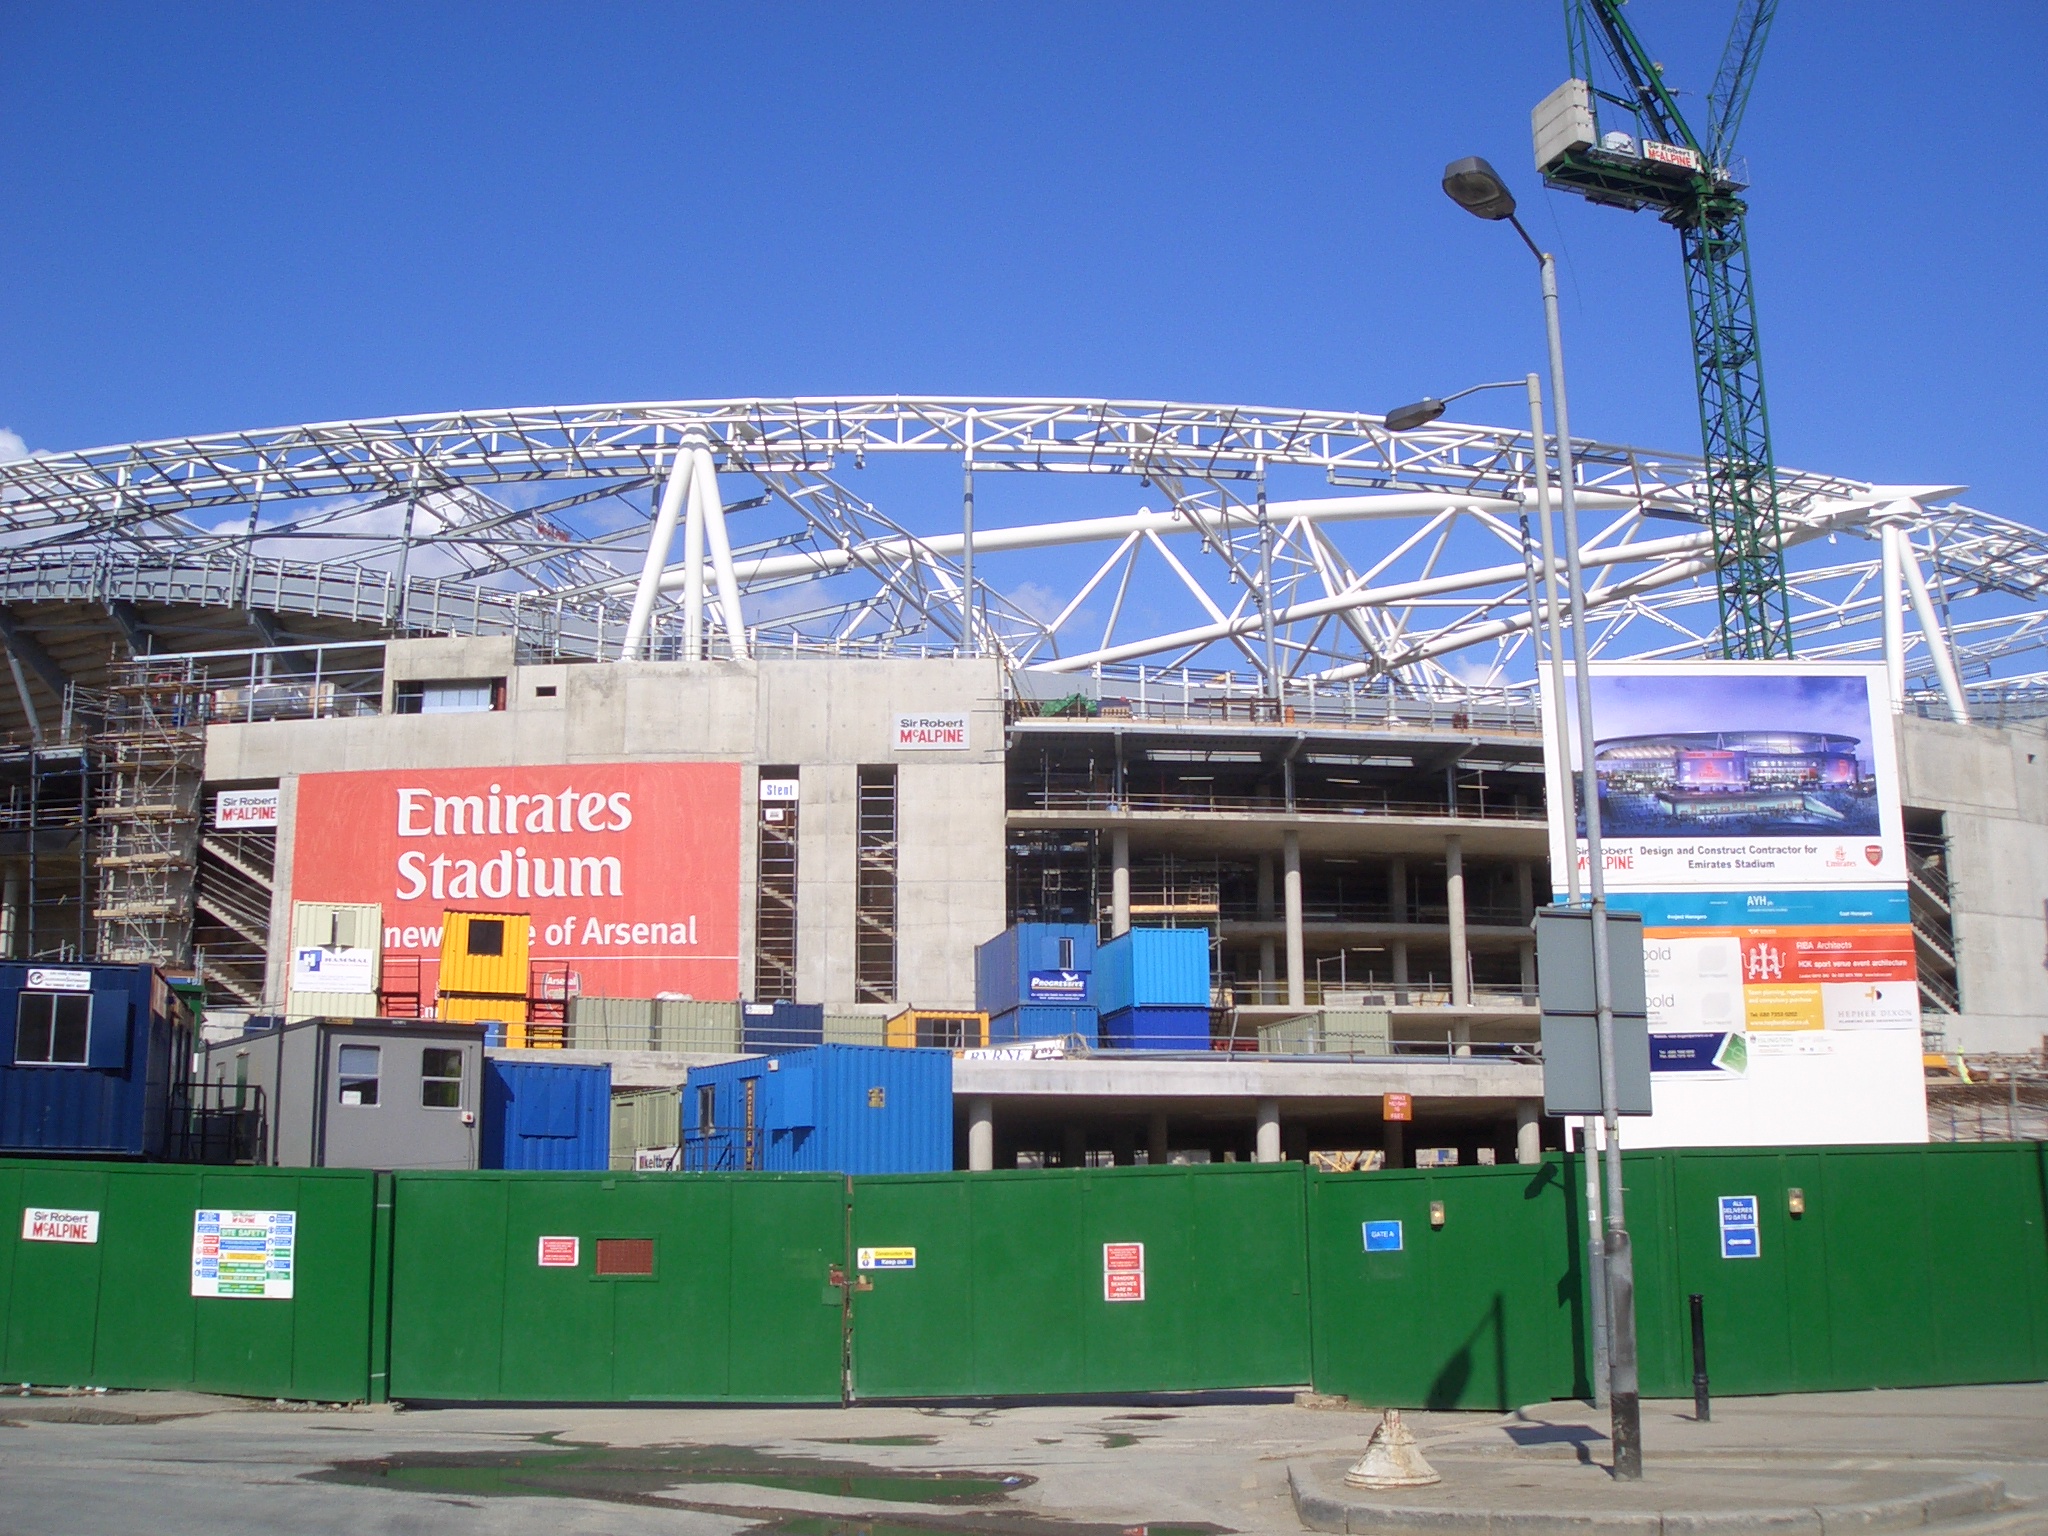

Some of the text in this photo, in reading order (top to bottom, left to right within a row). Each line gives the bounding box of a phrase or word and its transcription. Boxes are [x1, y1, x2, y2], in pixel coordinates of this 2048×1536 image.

[1661, 144, 1690, 156] Robert
[901, 719, 963, 728] Sir Robert
[900, 729, 964, 743] McALPINE
[223, 796, 277, 806] Sir Robert
[222, 807, 276, 821] McALPINE
[396, 783, 633, 837] Emirates
[1640, 845, 1818, 858] Design and Construct Contractor for
[1688, 859, 1775, 869] Emirates Stadium
[1826, 860, 1857, 868] Emirates
[396, 847, 624, 901] Stadium
[1747, 896, 1767, 906] AYH
[384, 926, 442, 949] new
[545, 917, 577, 946] of
[582, 915, 698, 946] Arsenal
[1817, 941, 1853, 950] Architects
[547, 976, 577, 986] Arseal
[34, 1211, 88, 1222] Sir Robert
[33, 1222, 87, 1239] McALPINE
[238, 1229, 266, 1237] SAFETY
